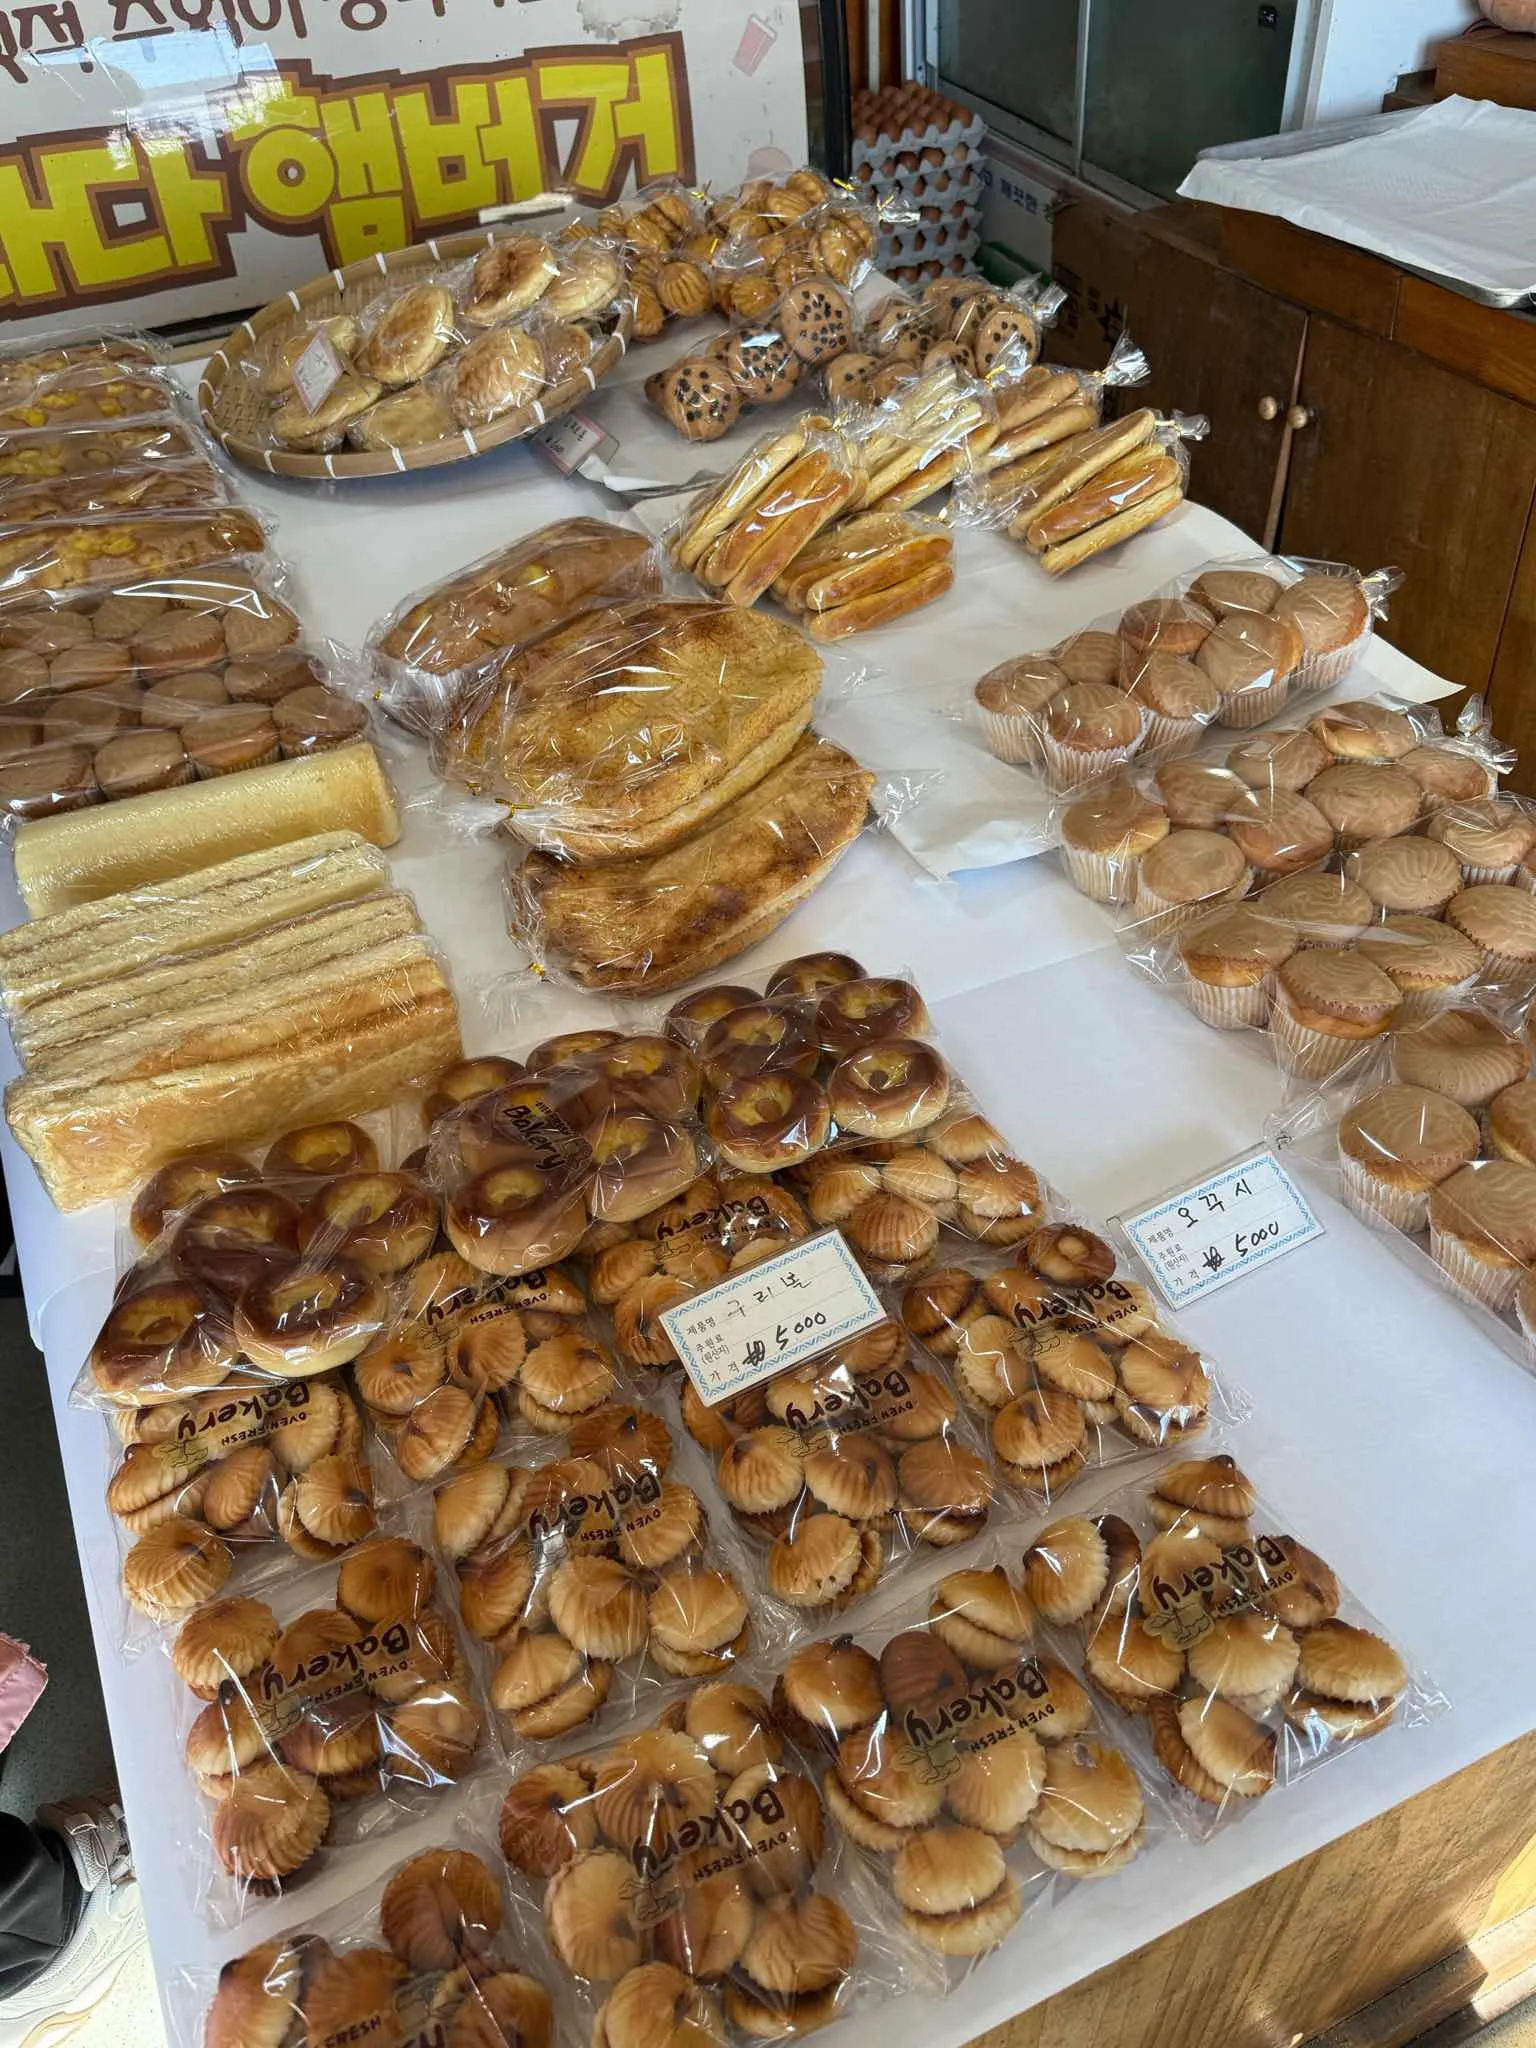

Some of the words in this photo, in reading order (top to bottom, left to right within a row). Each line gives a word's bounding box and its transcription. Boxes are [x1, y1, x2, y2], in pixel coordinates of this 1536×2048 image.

[657, 1196, 769, 1240] Bakery
[1148, 1228, 1174, 1244] 제품명
[1159, 1245, 1183, 1261] 주원료
[427, 1271, 546, 1325] Bakery
[513, 1293, 547, 1312] OVEN
[1015, 1281, 1132, 1328] Bakery
[470, 1304, 512, 1325] FRESH
[1106, 1304, 1138, 1323] OVEN
[686, 1317, 716, 1335] 제품명
[1067, 1319, 1106, 1335] FRESH
[696, 1335, 723, 1353] 주원료
[702, 1345, 730, 1366] (원산지)
[178, 1382, 310, 1440] Bakery
[786, 1370, 910, 1431] Bakery
[881, 1401, 914, 1419] OVEN
[270, 1411, 308, 1434] OVEN
[839, 1415, 878, 1435] FRESH
[221, 1423, 266, 1446] FRESH
[529, 1473, 661, 1538] Bakery
[624, 1508, 661, 1532] OVEN
[580, 1527, 623, 1542] FRESH
[1152, 1535, 1286, 1610] Bakery
[1260, 1571, 1293, 1594] OVEN
[263, 1623, 409, 1700] Bakery
[367, 1661, 408, 1681] OVEN
[906, 1661, 1049, 1745] Bakery
[1019, 1704, 1056, 1729] OVEN
[971, 1725, 1017, 1753] FRESH
[633, 1788, 785, 1881] Bakery
[748, 1833, 787, 1858] OVEN
[693, 1855, 745, 1882] FRESH
